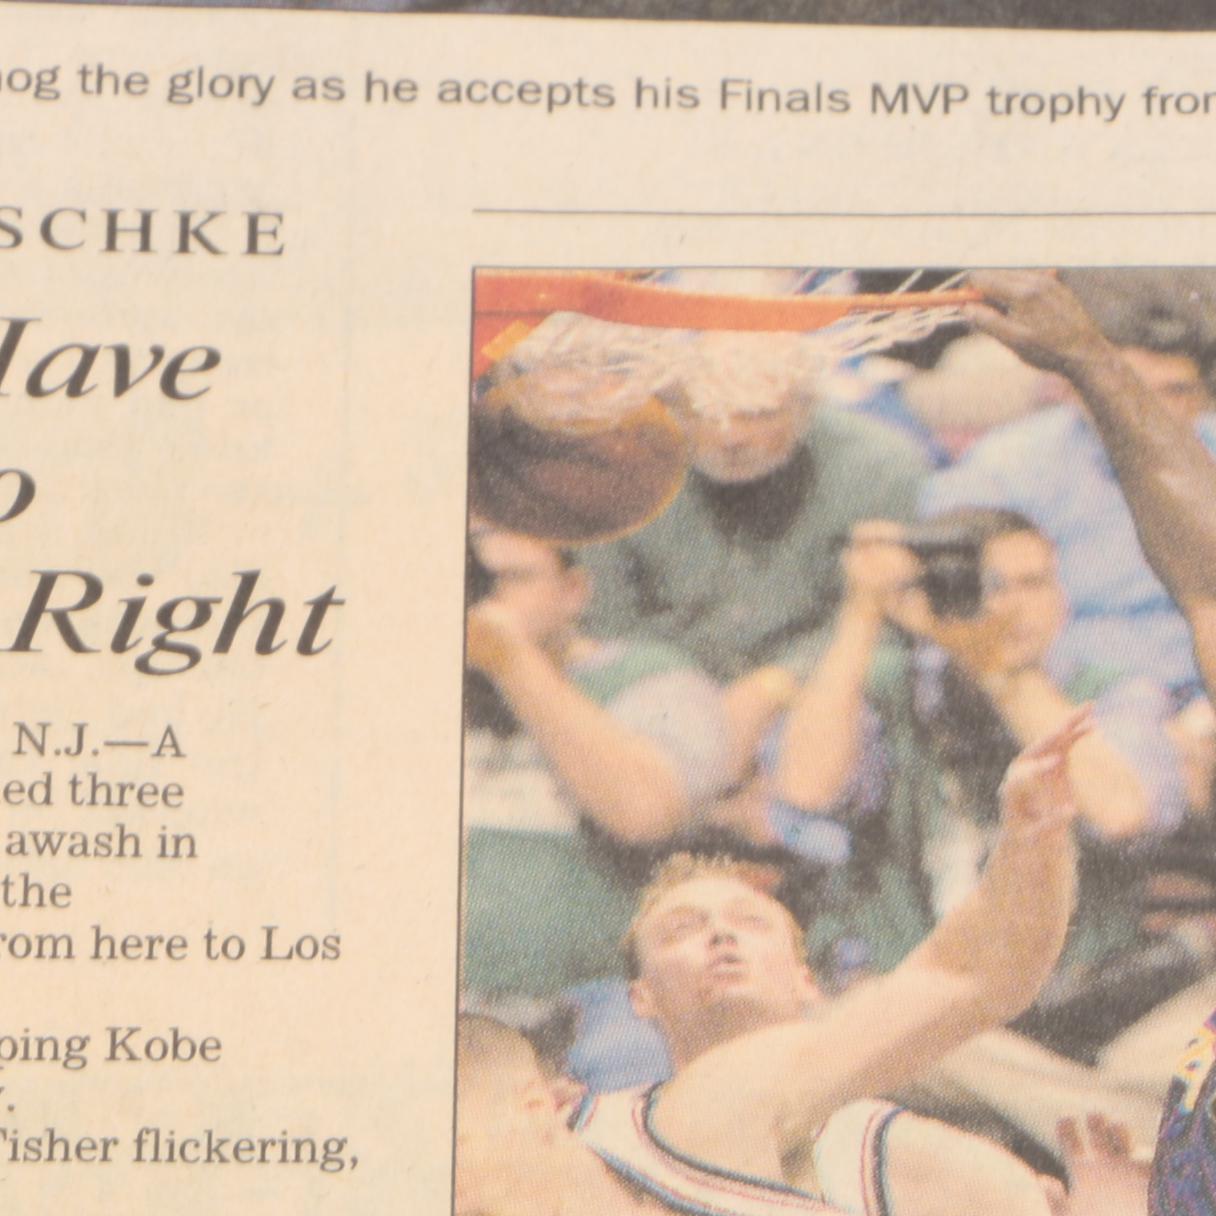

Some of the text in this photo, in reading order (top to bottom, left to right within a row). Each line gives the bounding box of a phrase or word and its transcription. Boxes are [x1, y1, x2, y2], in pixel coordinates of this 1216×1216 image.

[0, 66, 60, 101] og
[78, 64, 149, 96] the
[167, 66, 274, 106] glory
[292, 77, 345, 101] as
[365, 71, 418, 103] he
[438, 78, 615, 113] accepts
[636, 78, 700, 109] his
[721, 79, 850, 113] Finals
[872, 83, 969, 115] MVP
[986, 86, 1125, 123] trophy
[0, 570, 345, 677] Right
[69, 772, 184, 808] three
[6, 823, 197, 859] awash in
[1, 873, 71, 908] the
[90, 925, 188, 960] here
[204, 928, 245, 960] to
[261, 926, 340, 960] Los
[105, 1027, 221, 1062] Kobe
[0, 1127, 358, 1173] isher flickering,
